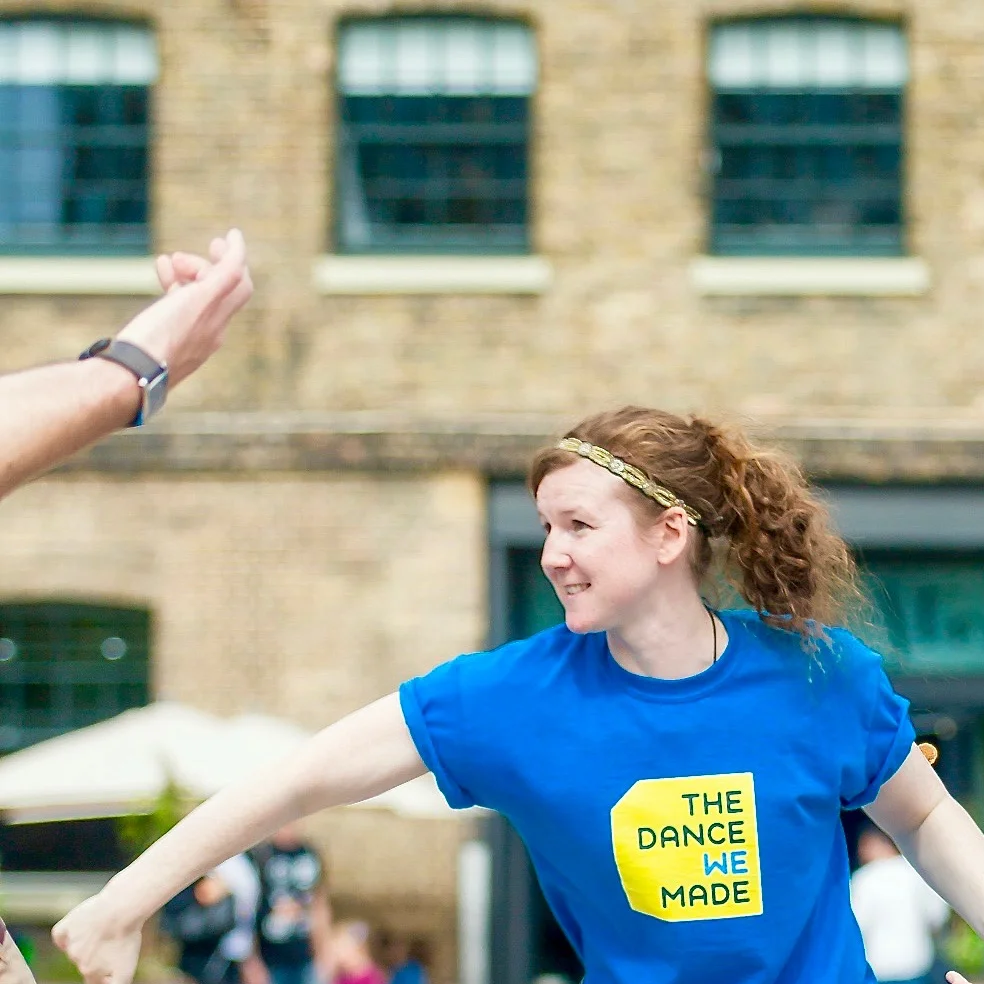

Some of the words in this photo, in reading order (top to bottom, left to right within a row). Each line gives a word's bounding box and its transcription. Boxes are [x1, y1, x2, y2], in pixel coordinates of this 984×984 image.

[681, 790, 743, 816] THE
[637, 820, 746, 850] DANCE
[703, 850, 748, 876] WE
[661, 880, 750, 909] MADE
